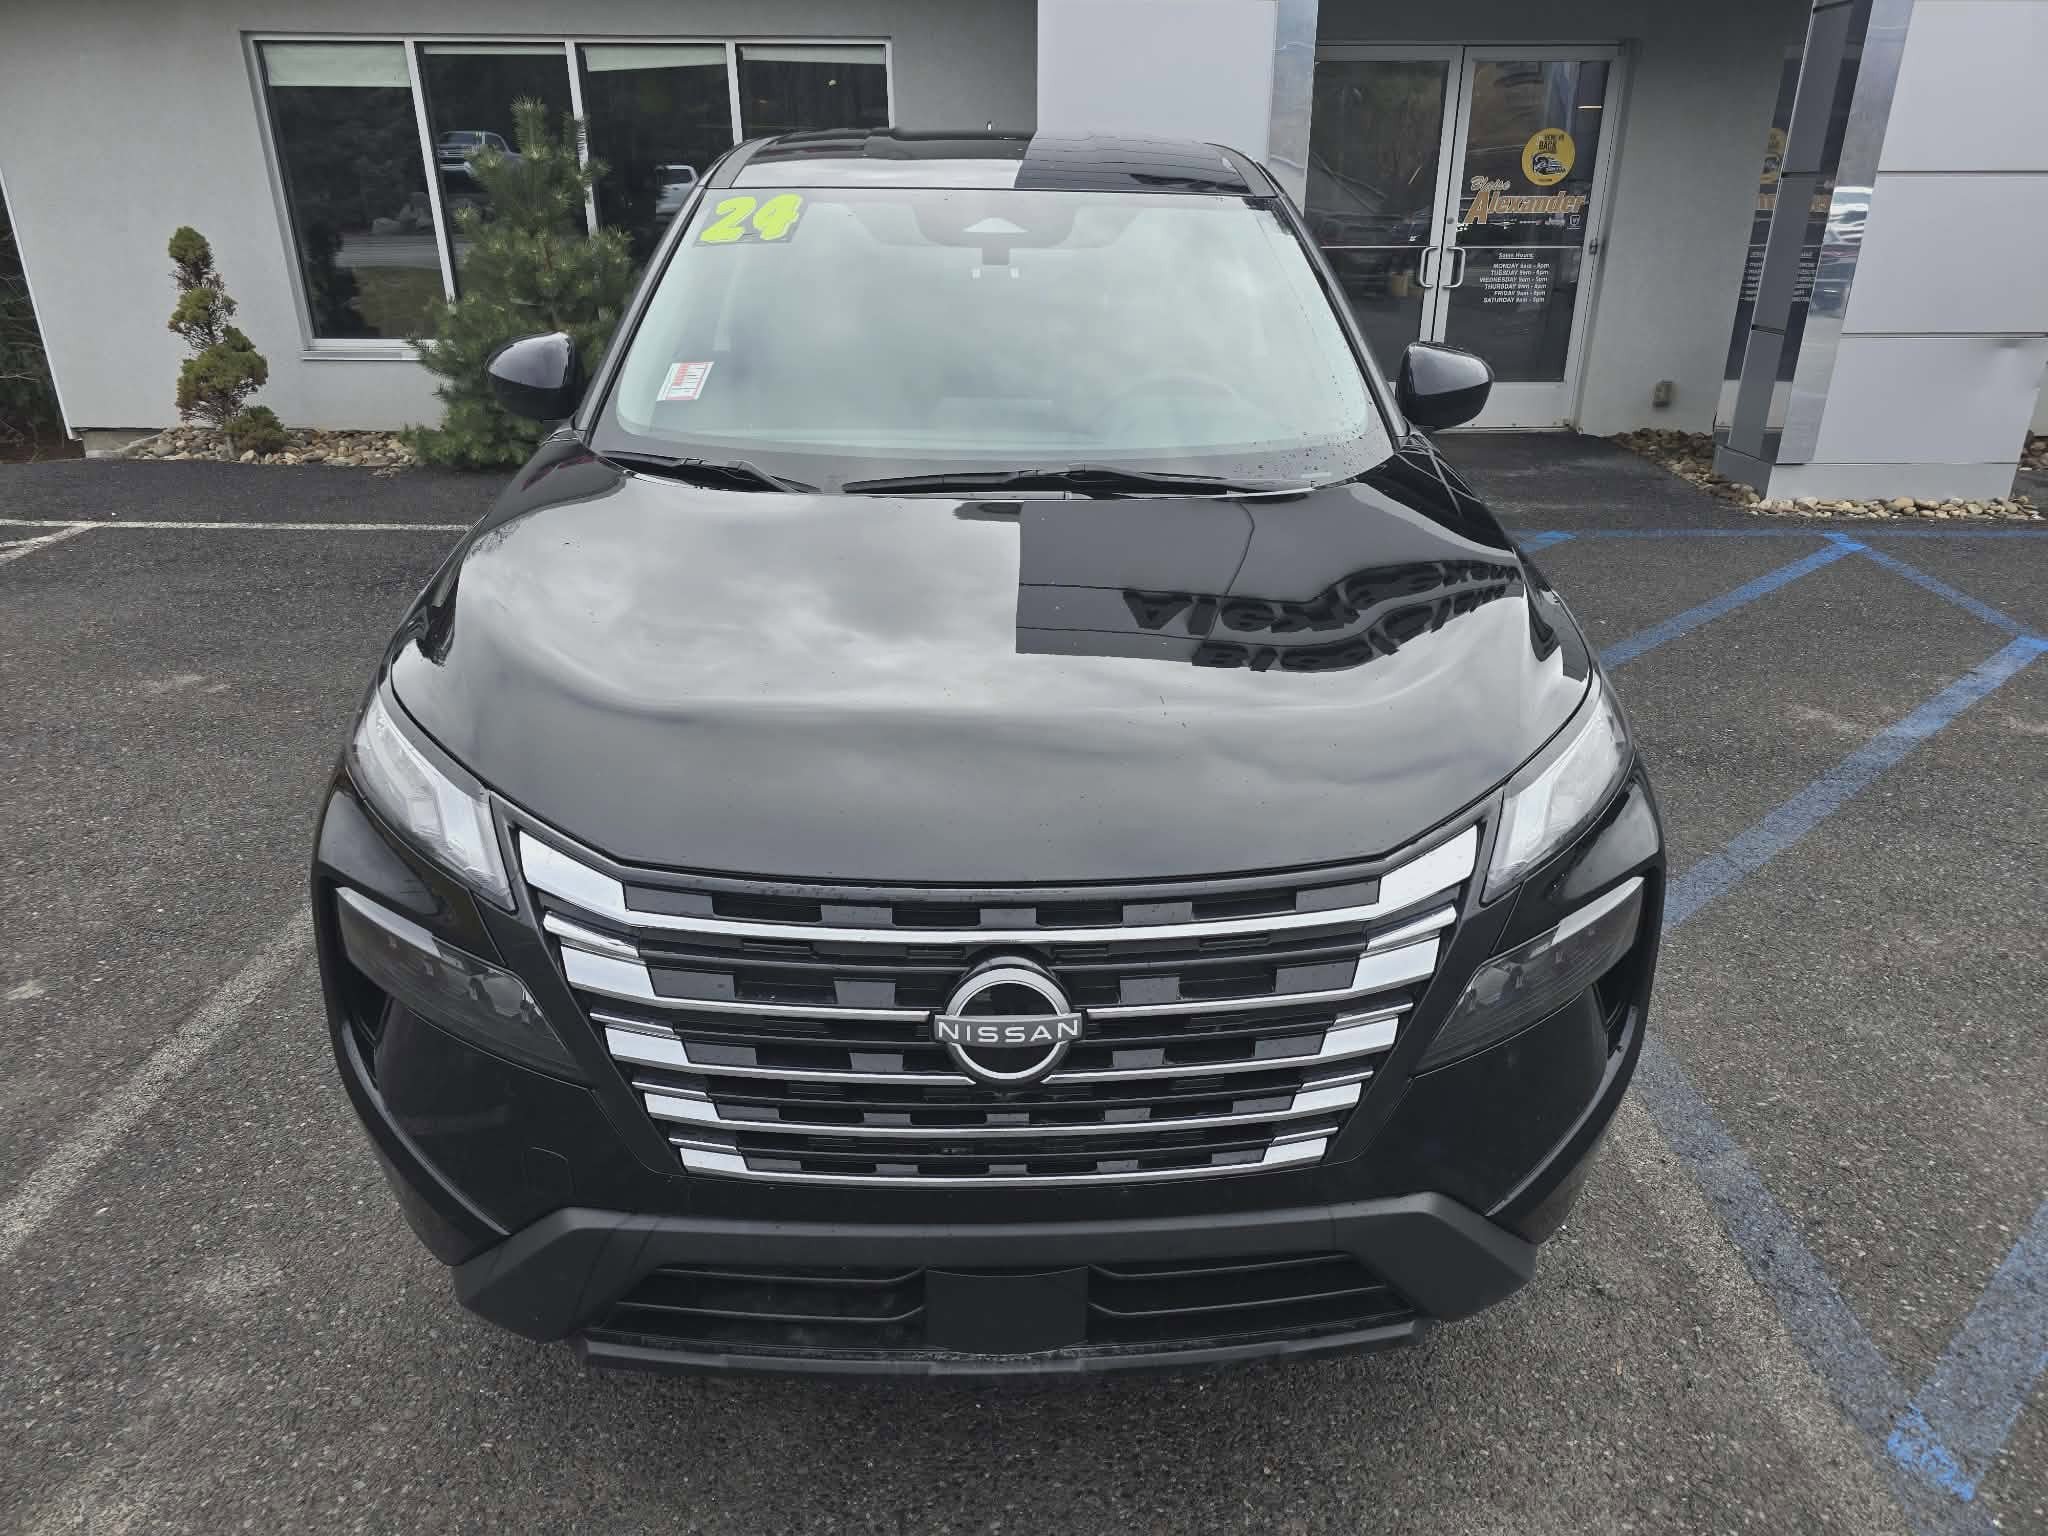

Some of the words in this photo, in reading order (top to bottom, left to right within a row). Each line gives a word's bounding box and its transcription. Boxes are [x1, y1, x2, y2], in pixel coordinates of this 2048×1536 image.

[1471, 176, 1511, 191] Blaise
[699, 193, 803, 244] 24
[1463, 189, 1586, 224] Alexander
[938, 1020, 1078, 1043] NISSAN
